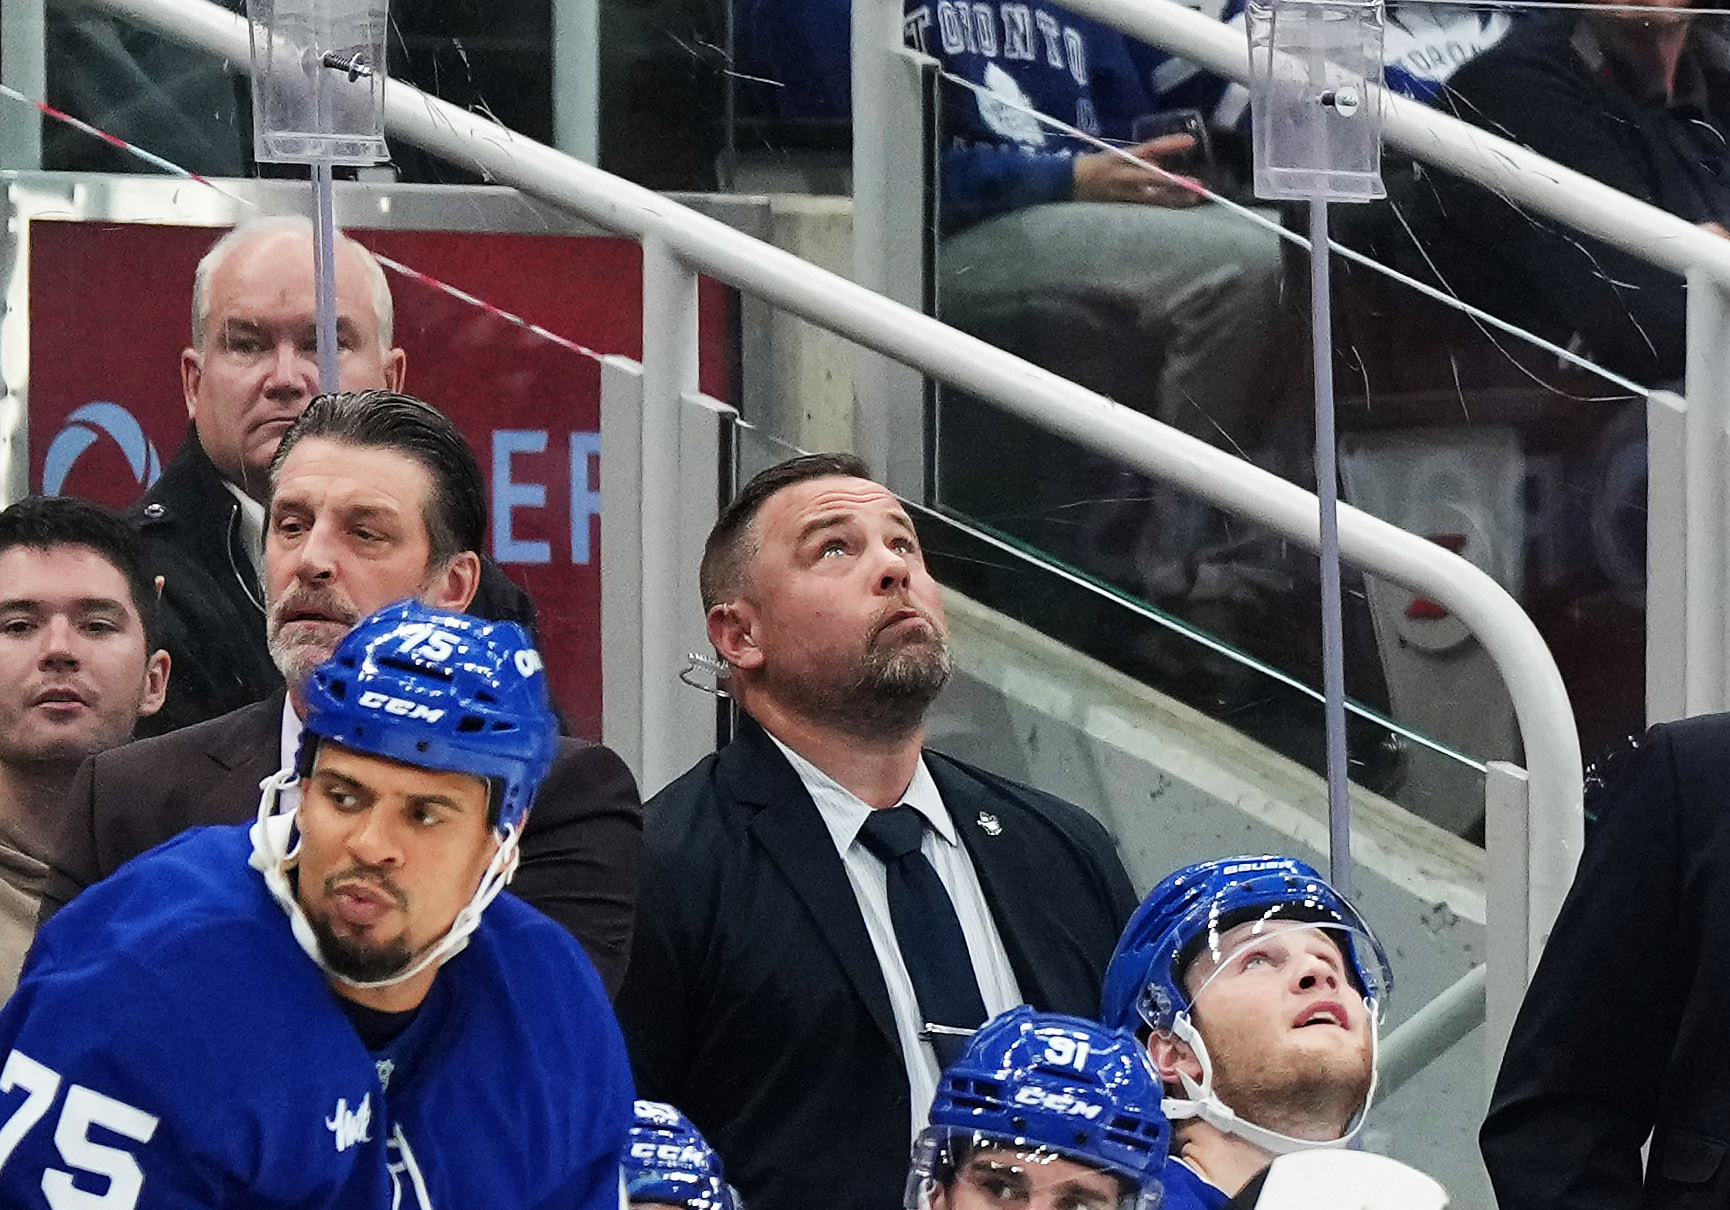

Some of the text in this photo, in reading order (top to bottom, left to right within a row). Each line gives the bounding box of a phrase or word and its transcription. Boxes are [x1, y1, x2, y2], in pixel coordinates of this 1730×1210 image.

[400, 622, 462, 662] 75
[358, 690, 446, 725] CCM
[1044, 1035, 1091, 1073] 91
[1014, 1084, 1103, 1120] CCM
[630, 1142, 709, 1170] CCM
